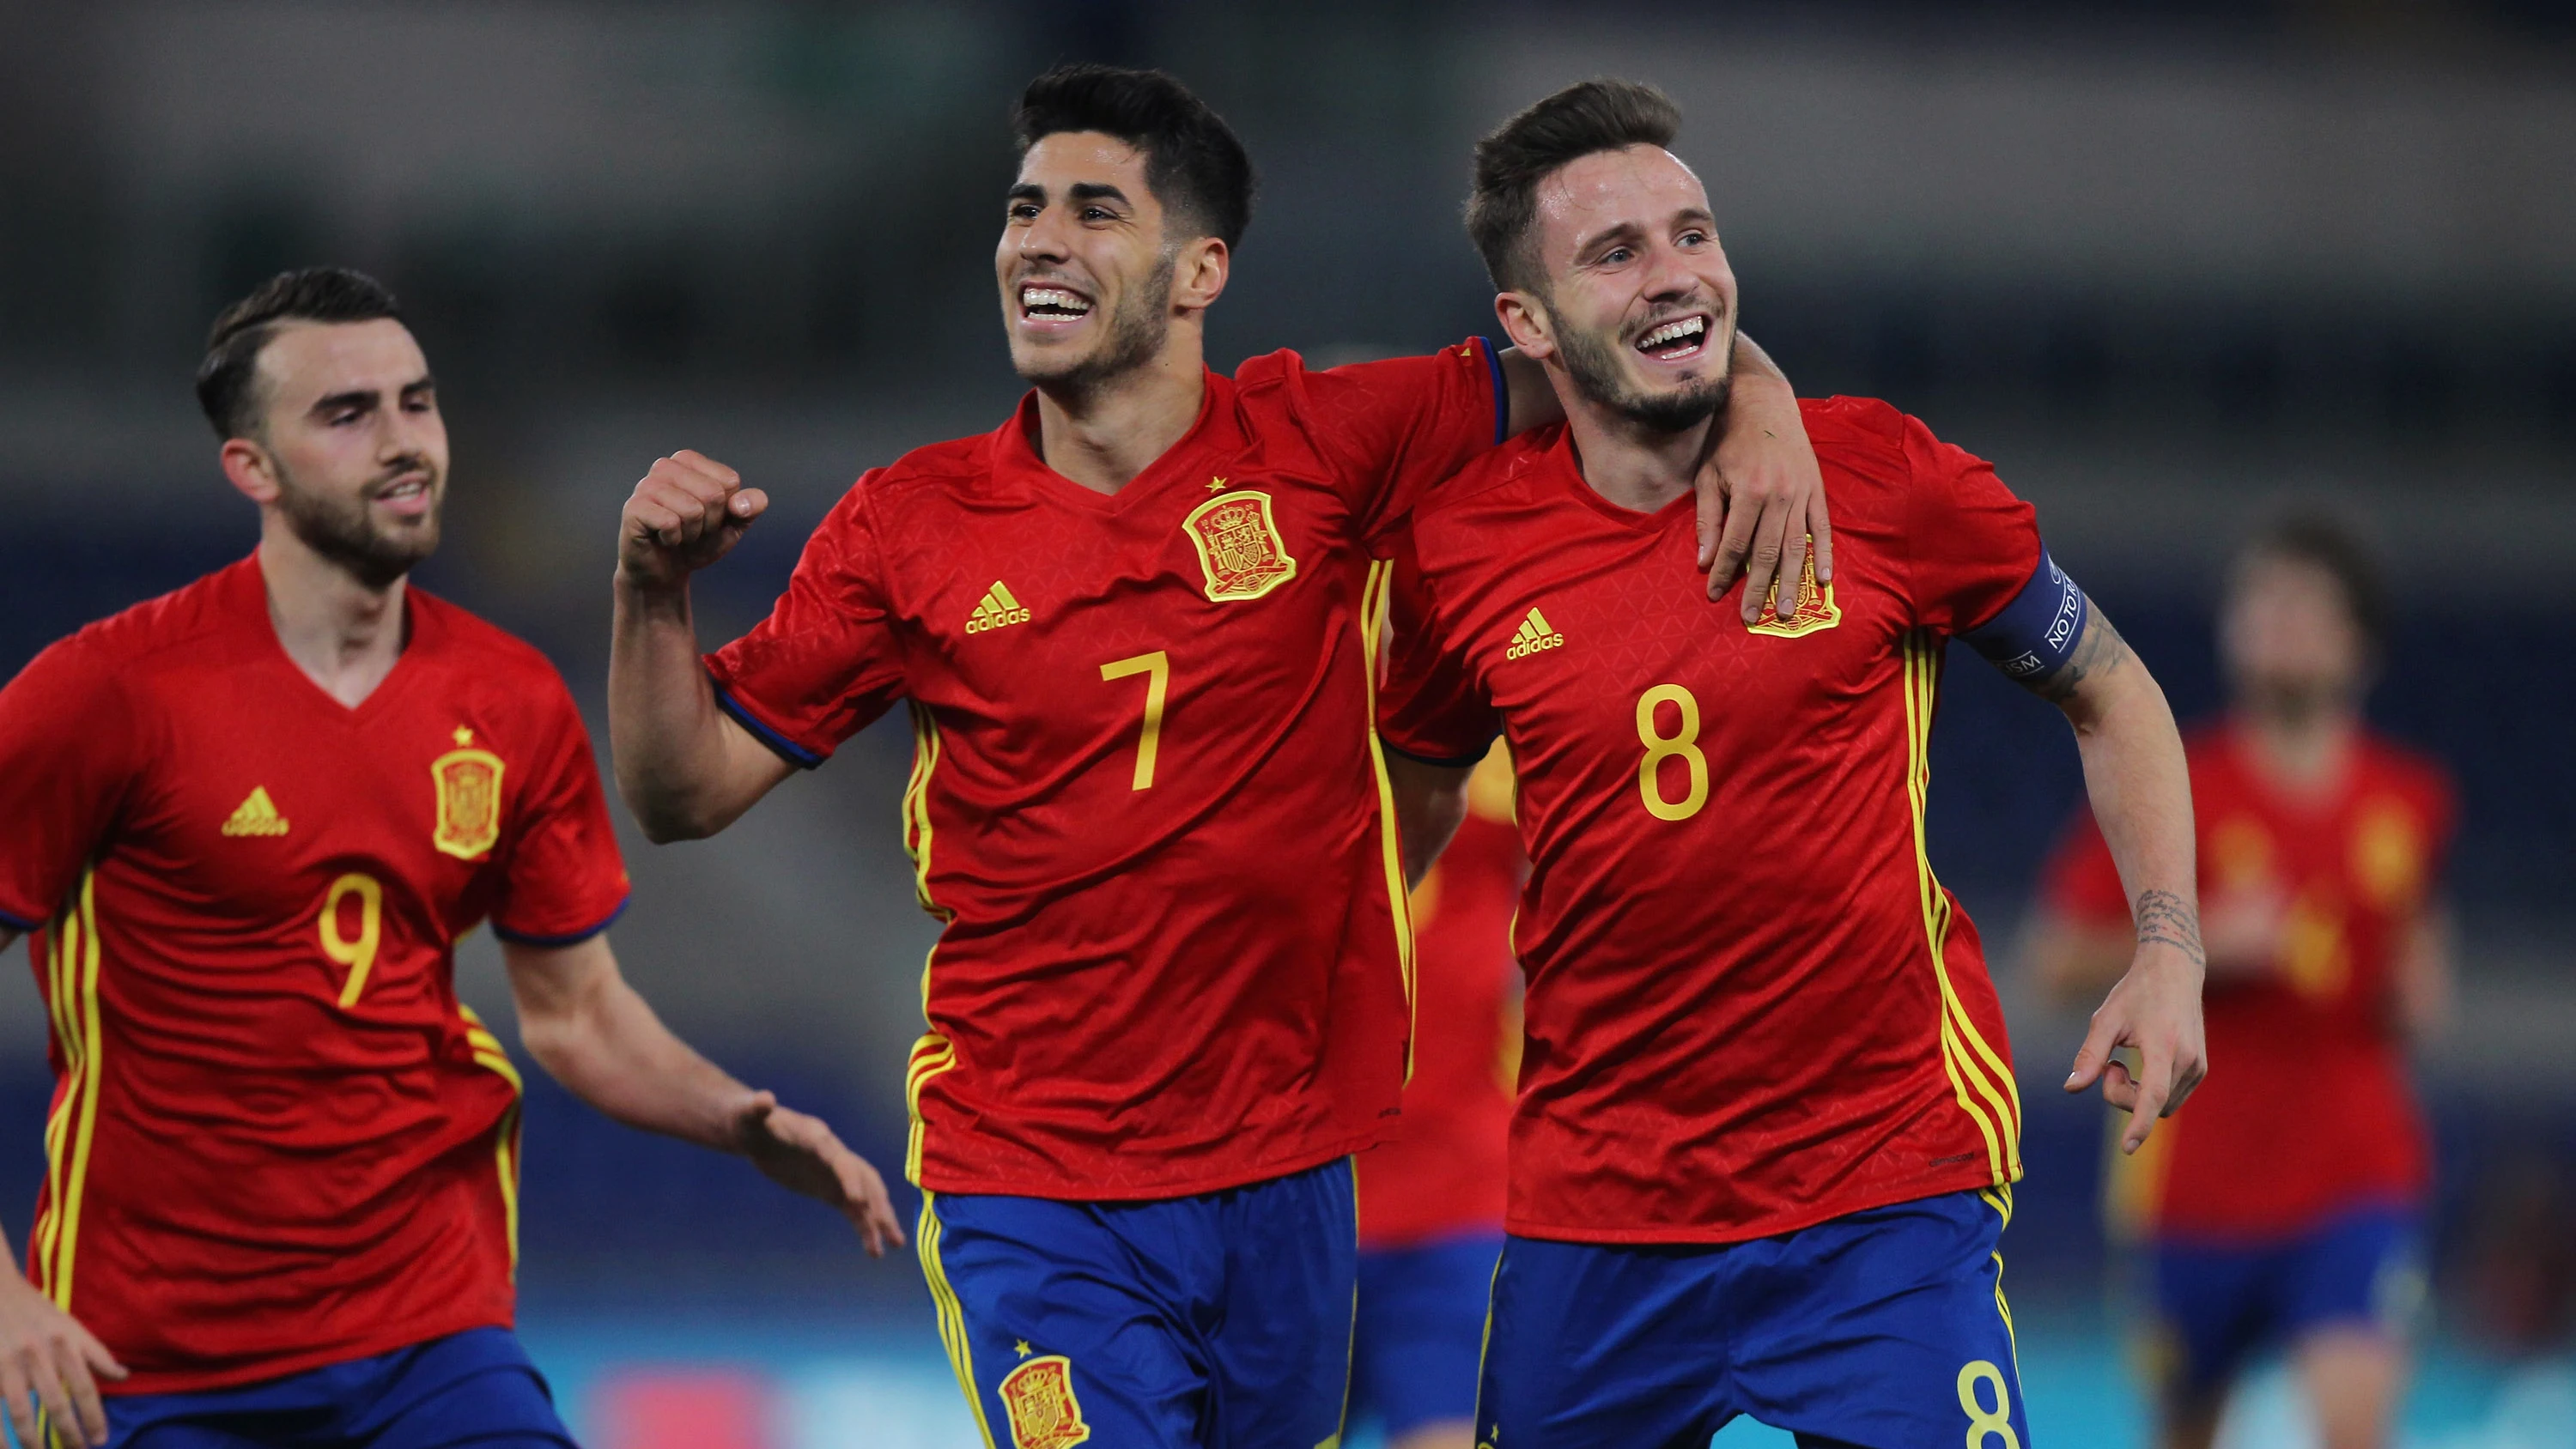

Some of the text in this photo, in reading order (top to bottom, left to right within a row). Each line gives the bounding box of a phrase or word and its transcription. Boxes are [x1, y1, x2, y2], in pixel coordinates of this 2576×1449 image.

[964, 608, 1031, 634] adidas
[1506, 632, 1564, 661] adidas
[2048, 619, 2069, 650] NO
[2063, 595, 2077, 618] TO
[1099, 650, 1170, 791] 7
[1636, 683, 1709, 822] 8
[319, 874, 380, 1009] 9
[1955, 1360, 2021, 1449] 8
